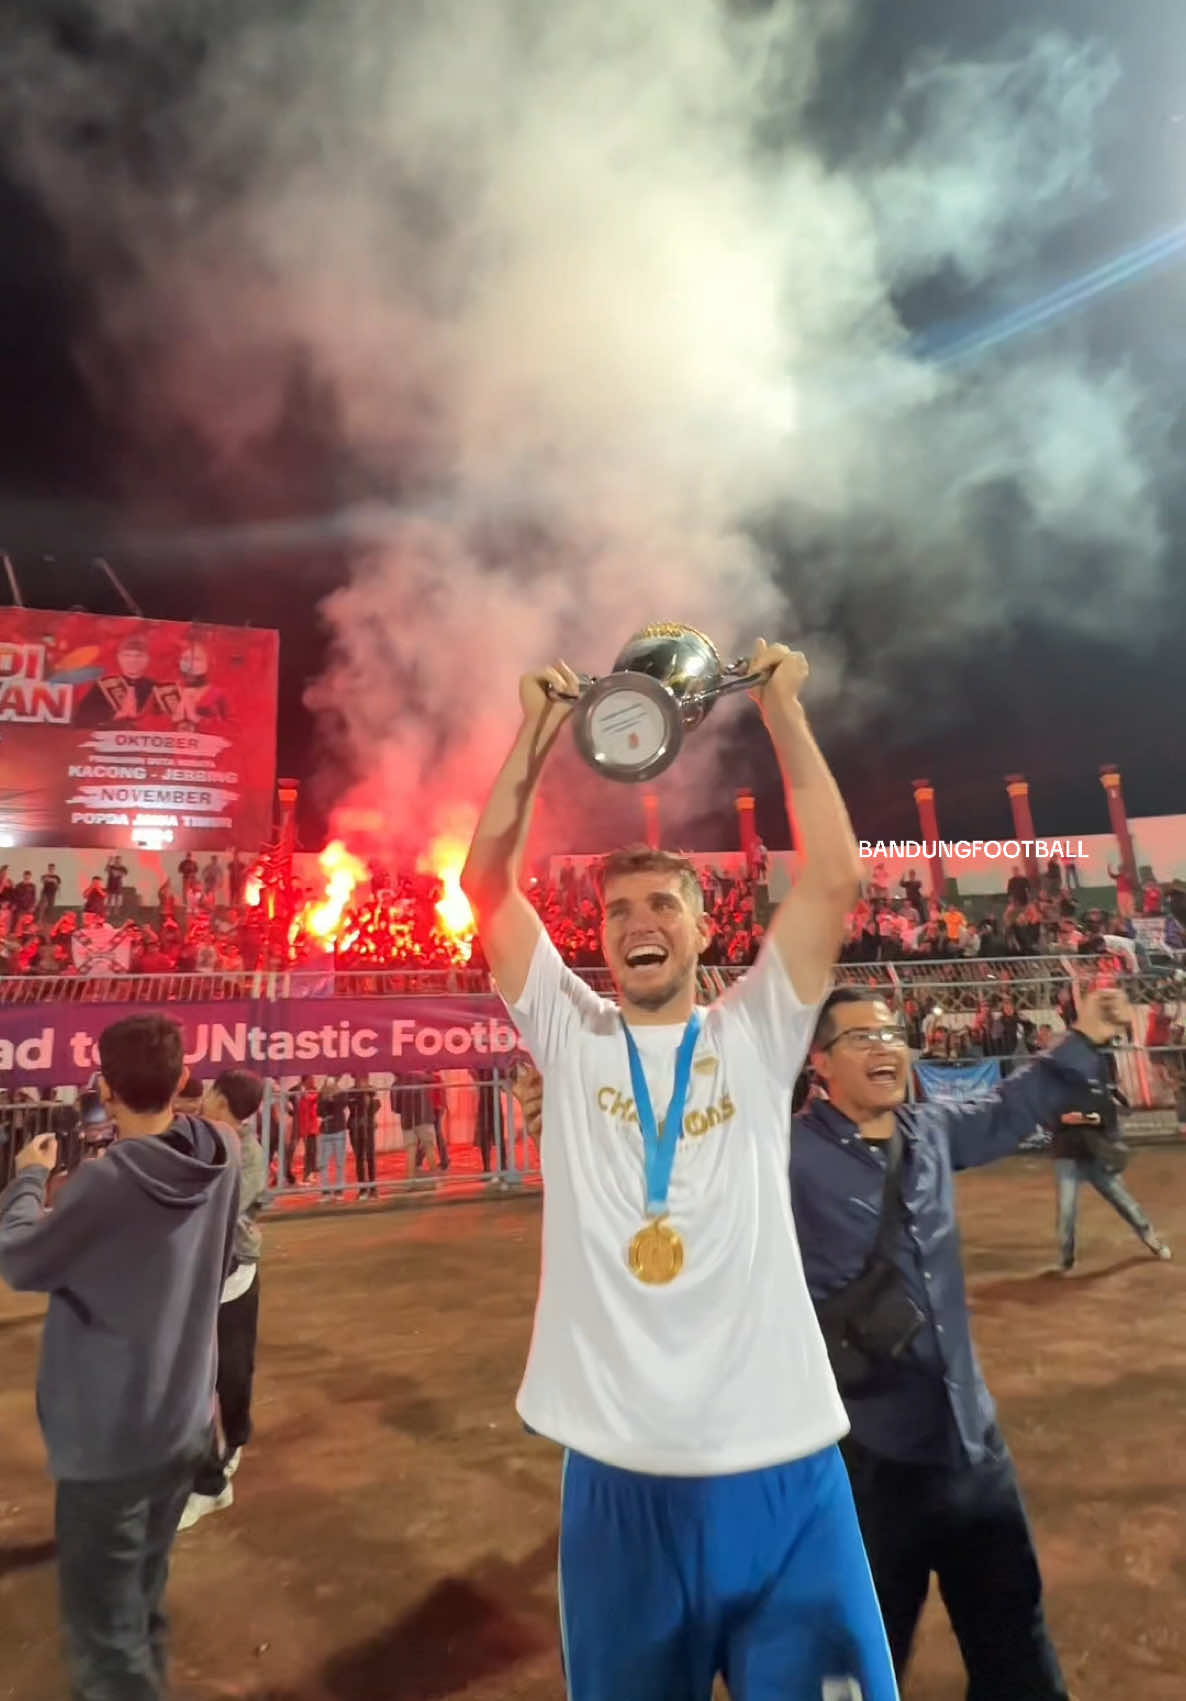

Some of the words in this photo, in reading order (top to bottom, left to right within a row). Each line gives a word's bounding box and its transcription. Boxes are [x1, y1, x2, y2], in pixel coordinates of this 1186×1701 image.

[115, 734, 200, 749] OKTOBER
[68, 765, 147, 779] KACONG
[102, 788, 213, 805] NOVEMBER
[70, 1031, 101, 1067] t
[183, 1021, 378, 1063] UNtastic
[392, 1017, 526, 1058] Footb
